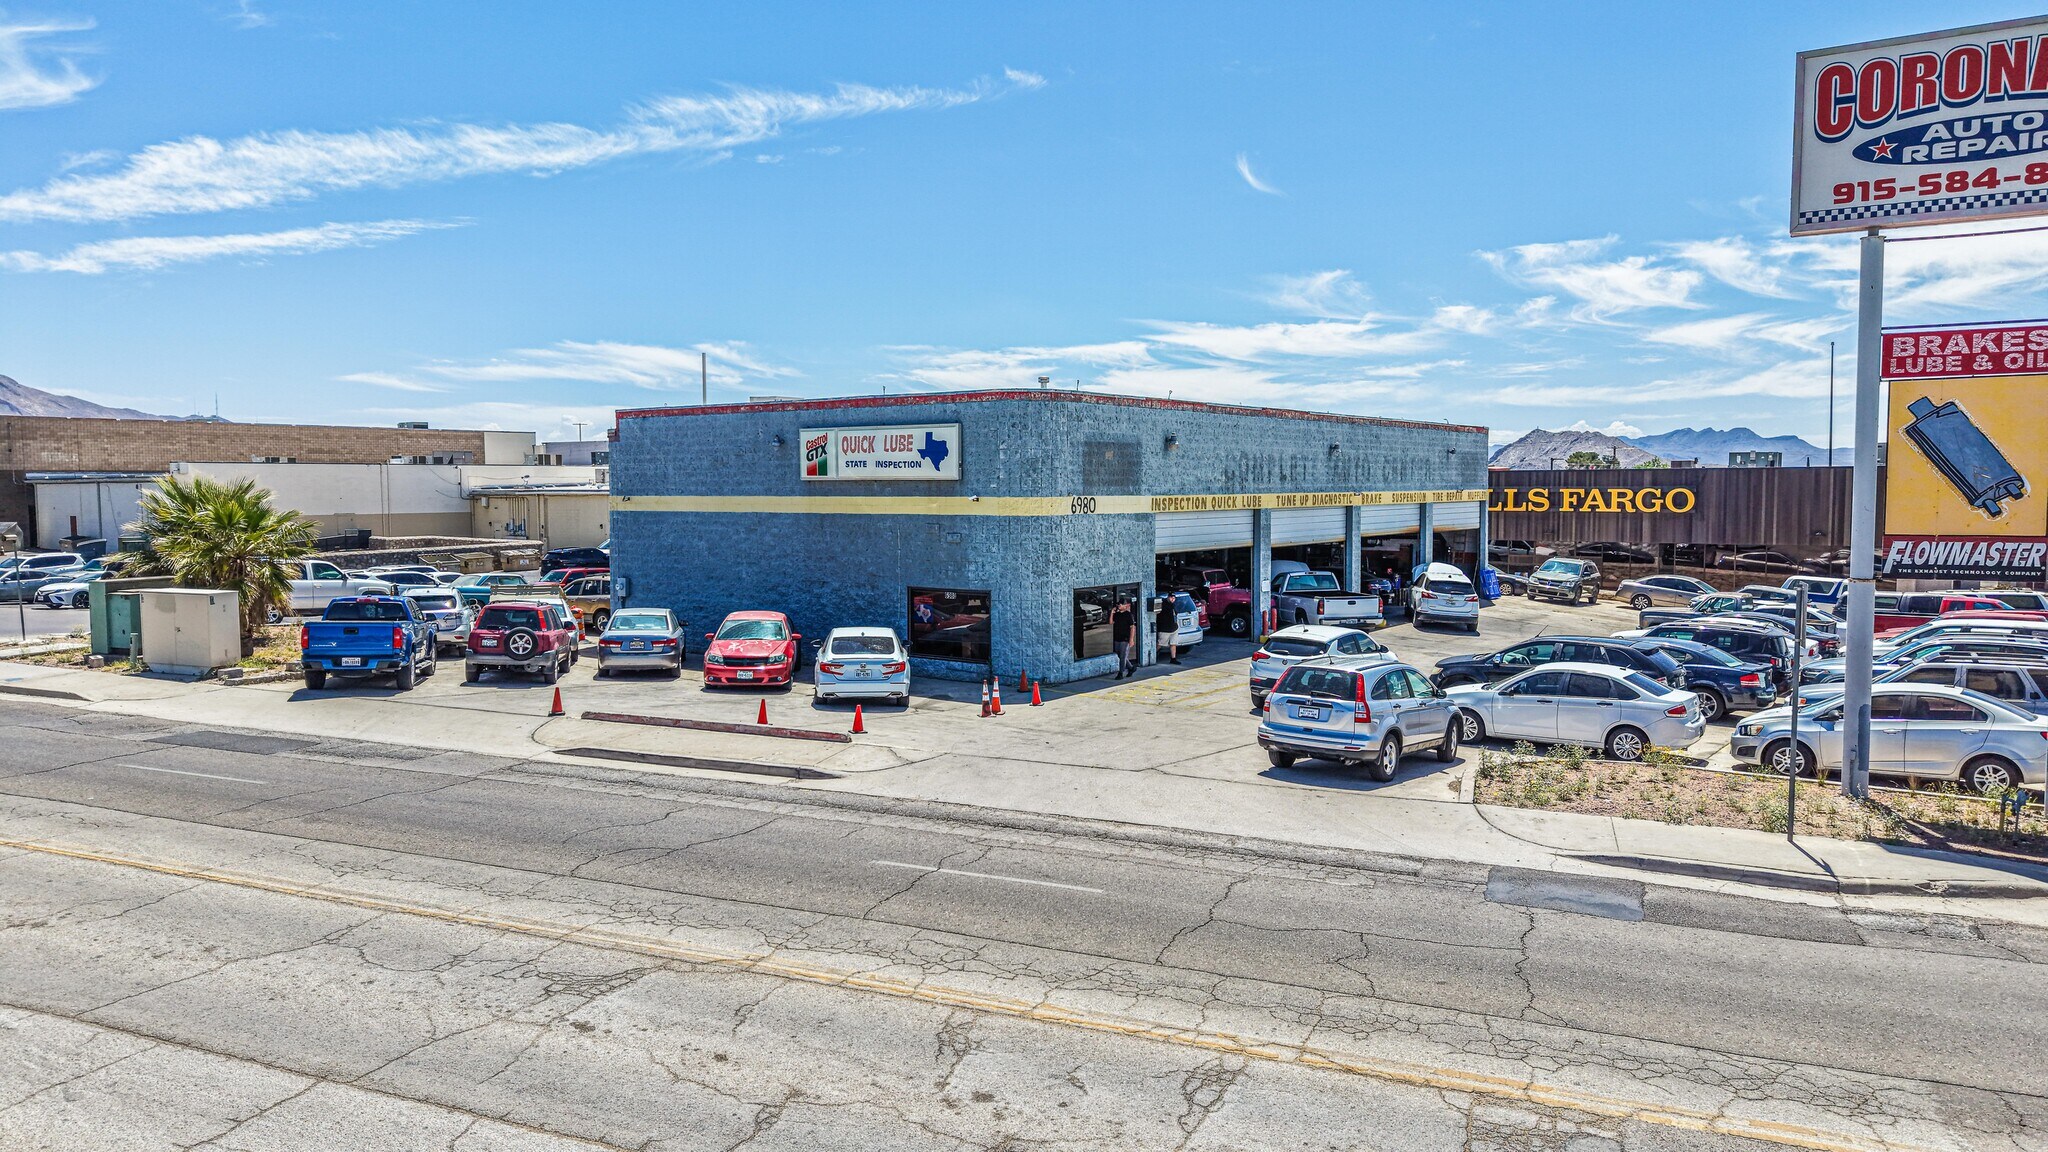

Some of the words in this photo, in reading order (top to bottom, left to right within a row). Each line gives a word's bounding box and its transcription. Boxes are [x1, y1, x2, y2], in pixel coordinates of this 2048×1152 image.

[1921, 112, 2044, 142] AUTO
[1902, 130, 2048, 163] REPAIR
[1893, 329, 2048, 357] BRAKES
[1890, 355, 1962, 373] LUBE
[1973, 354, 1993, 370] &
[2004, 352, 2048, 369] OIL
[806, 432, 828, 450] Castrol
[841, 435, 875, 455] QUICK
[883, 434, 914, 452] LUBE
[806, 443, 828, 462] GTX
[845, 460, 867, 468] STATE
[875, 460, 922, 468] INSPECTION
[1071, 496, 1096, 515] 6980
[1151, 497, 1207, 511] INSPECTION
[1211, 496, 1237, 511] QUICK
[1241, 495, 1262, 508] LUBE
[1276, 494, 1297, 507] TUNE
[1300, 494, 1309, 506] UP
[1312, 493, 1353, 506] DIAGNOSTIC
[1361, 493, 1382, 504] BRAKE
[1391, 492, 1427, 503] SUSPENSION
[1433, 492, 1443, 501] TIRE
[1446, 491, 1462, 501] REPAIR
[1559, 487, 1696, 513] FARGO
[1883, 541, 2047, 574] FLOWMASTER
